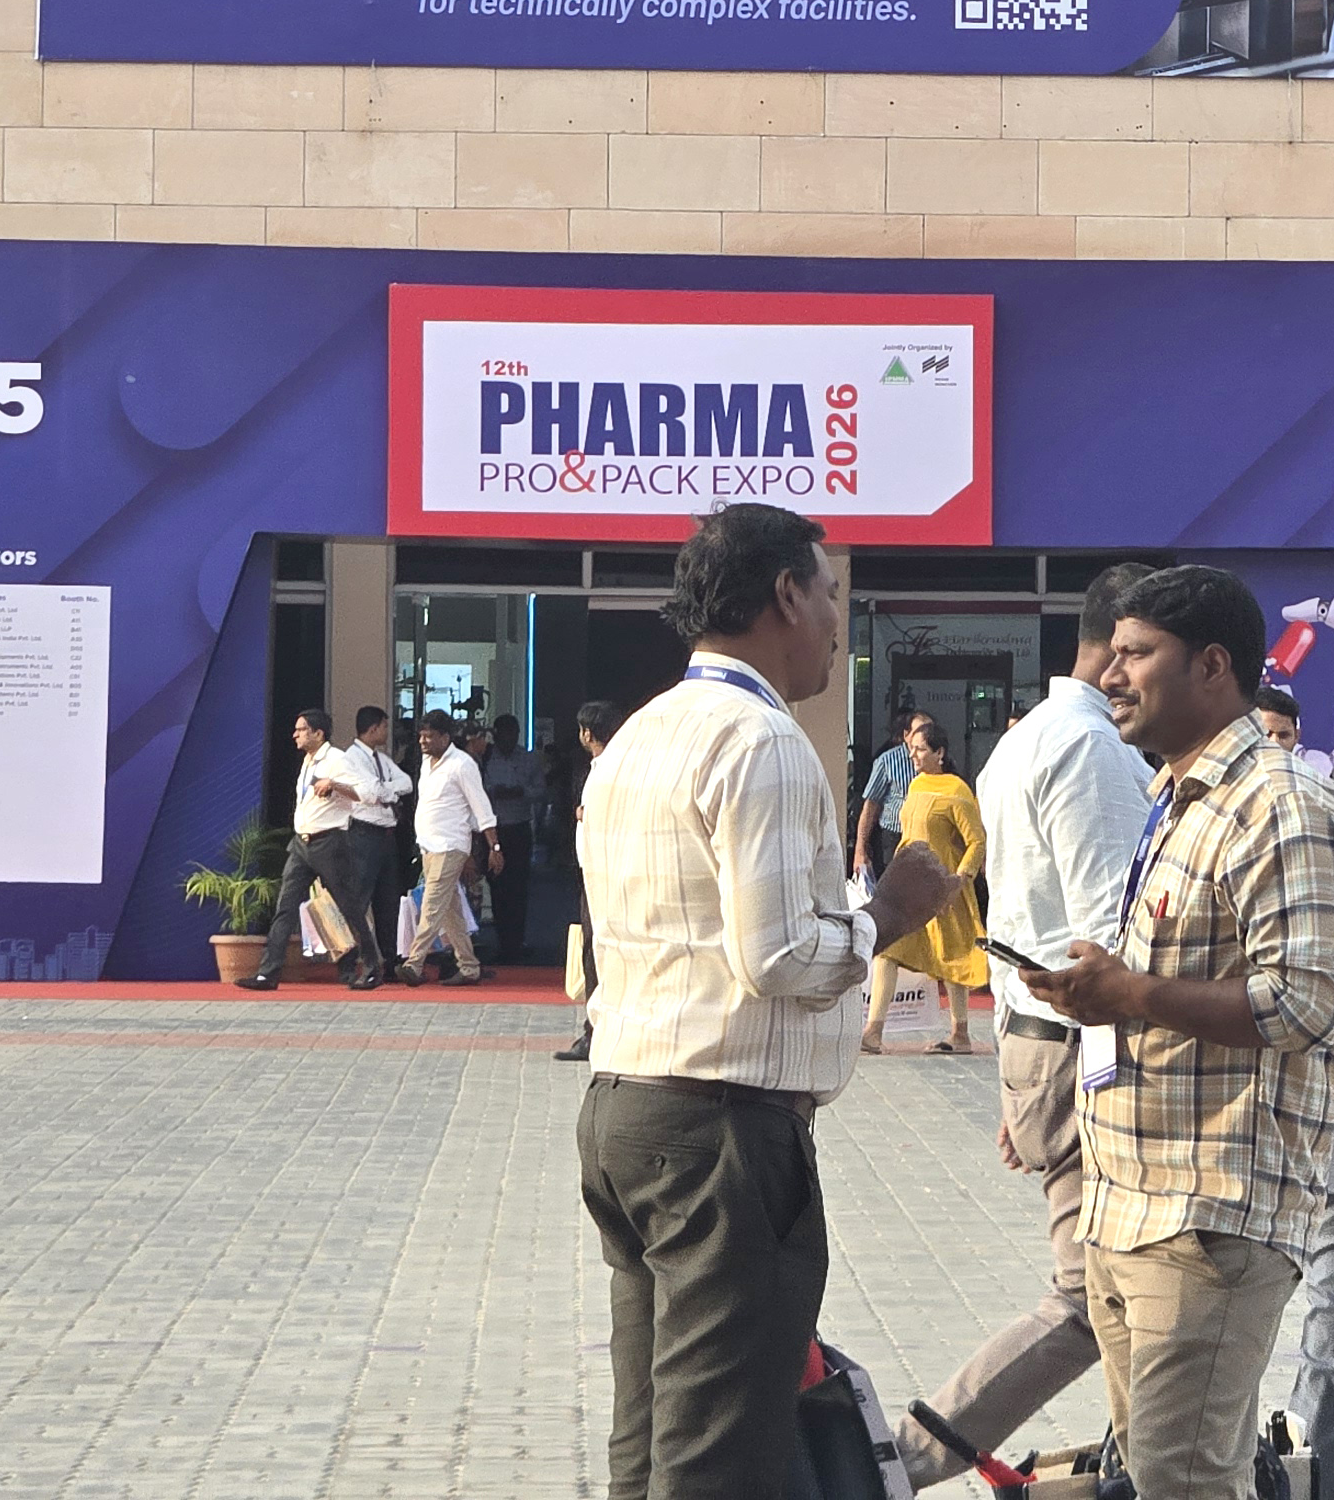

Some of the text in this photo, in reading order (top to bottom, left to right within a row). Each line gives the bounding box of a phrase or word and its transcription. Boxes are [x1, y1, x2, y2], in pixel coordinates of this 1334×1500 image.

[944, 344, 954, 352] by
[482, 360, 528, 376] 12th
[481, 381, 814, 457] PHARMA
[826, 384, 857, 495] 2026
[713, 466, 814, 495] EXPO
